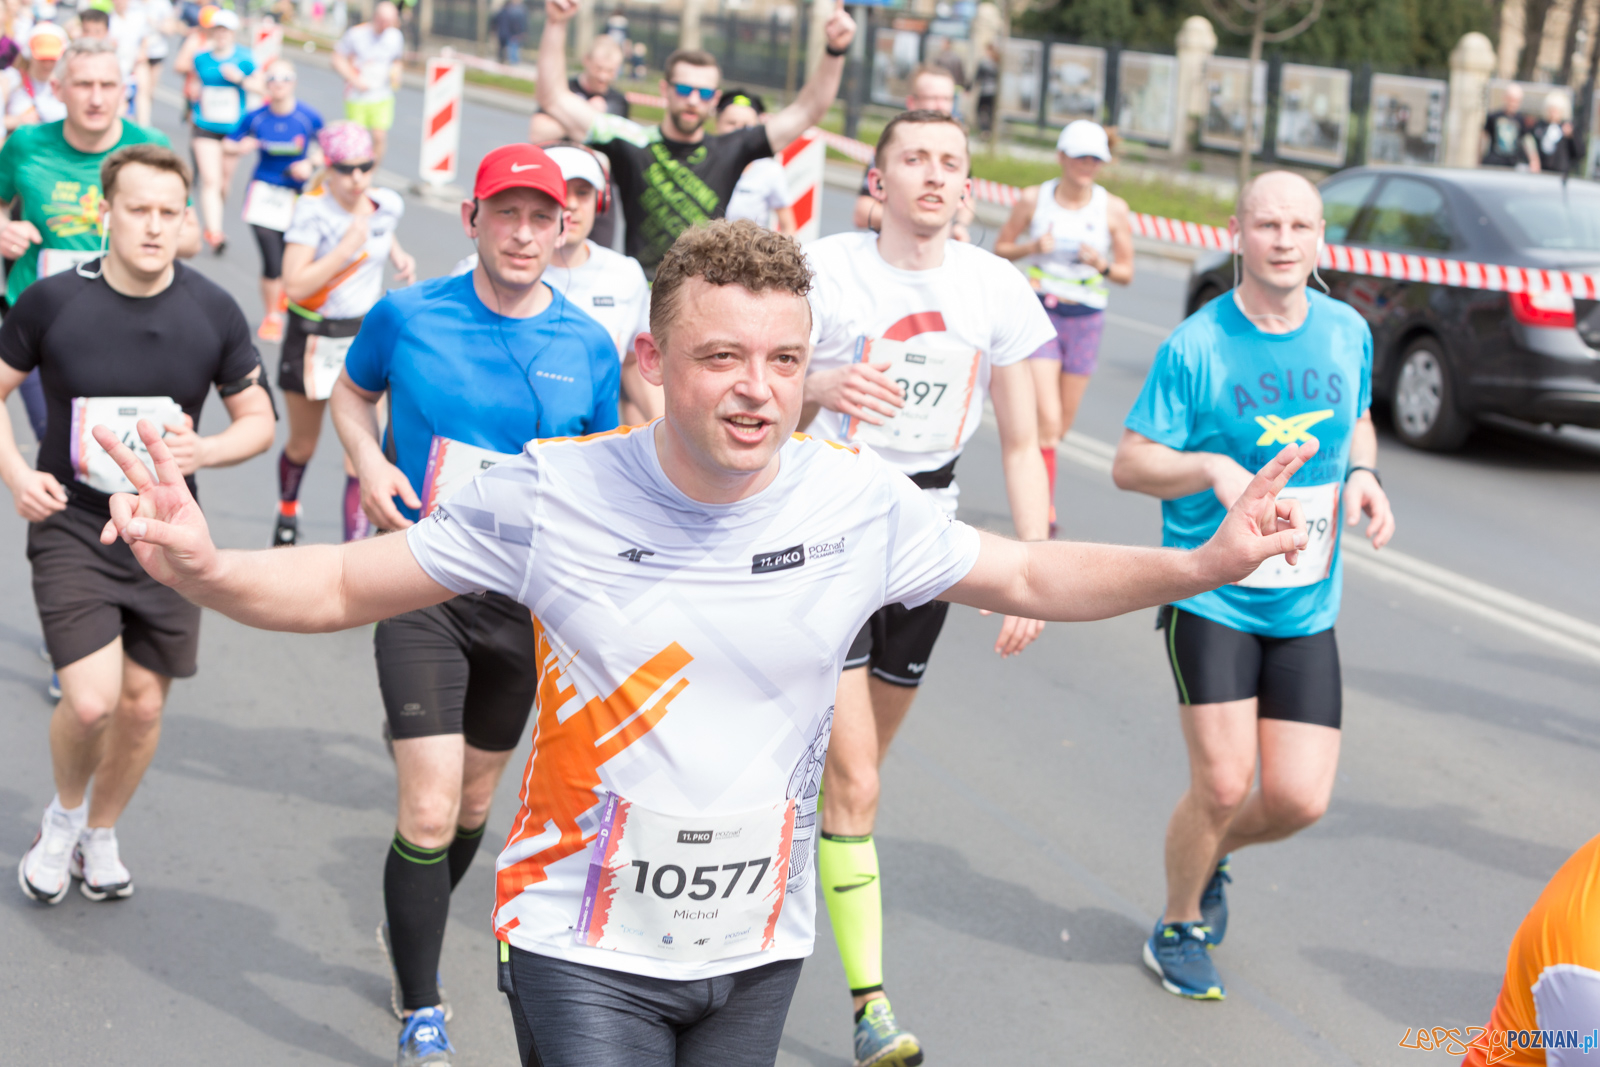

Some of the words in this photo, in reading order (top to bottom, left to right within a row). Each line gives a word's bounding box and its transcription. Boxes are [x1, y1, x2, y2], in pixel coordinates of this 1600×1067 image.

[1232, 368, 1342, 416] ASICS
[774, 551, 801, 566] PKO
[600, 828, 609, 838] D
[692, 833, 710, 841] PKO
[631, 856, 772, 902] 10577
